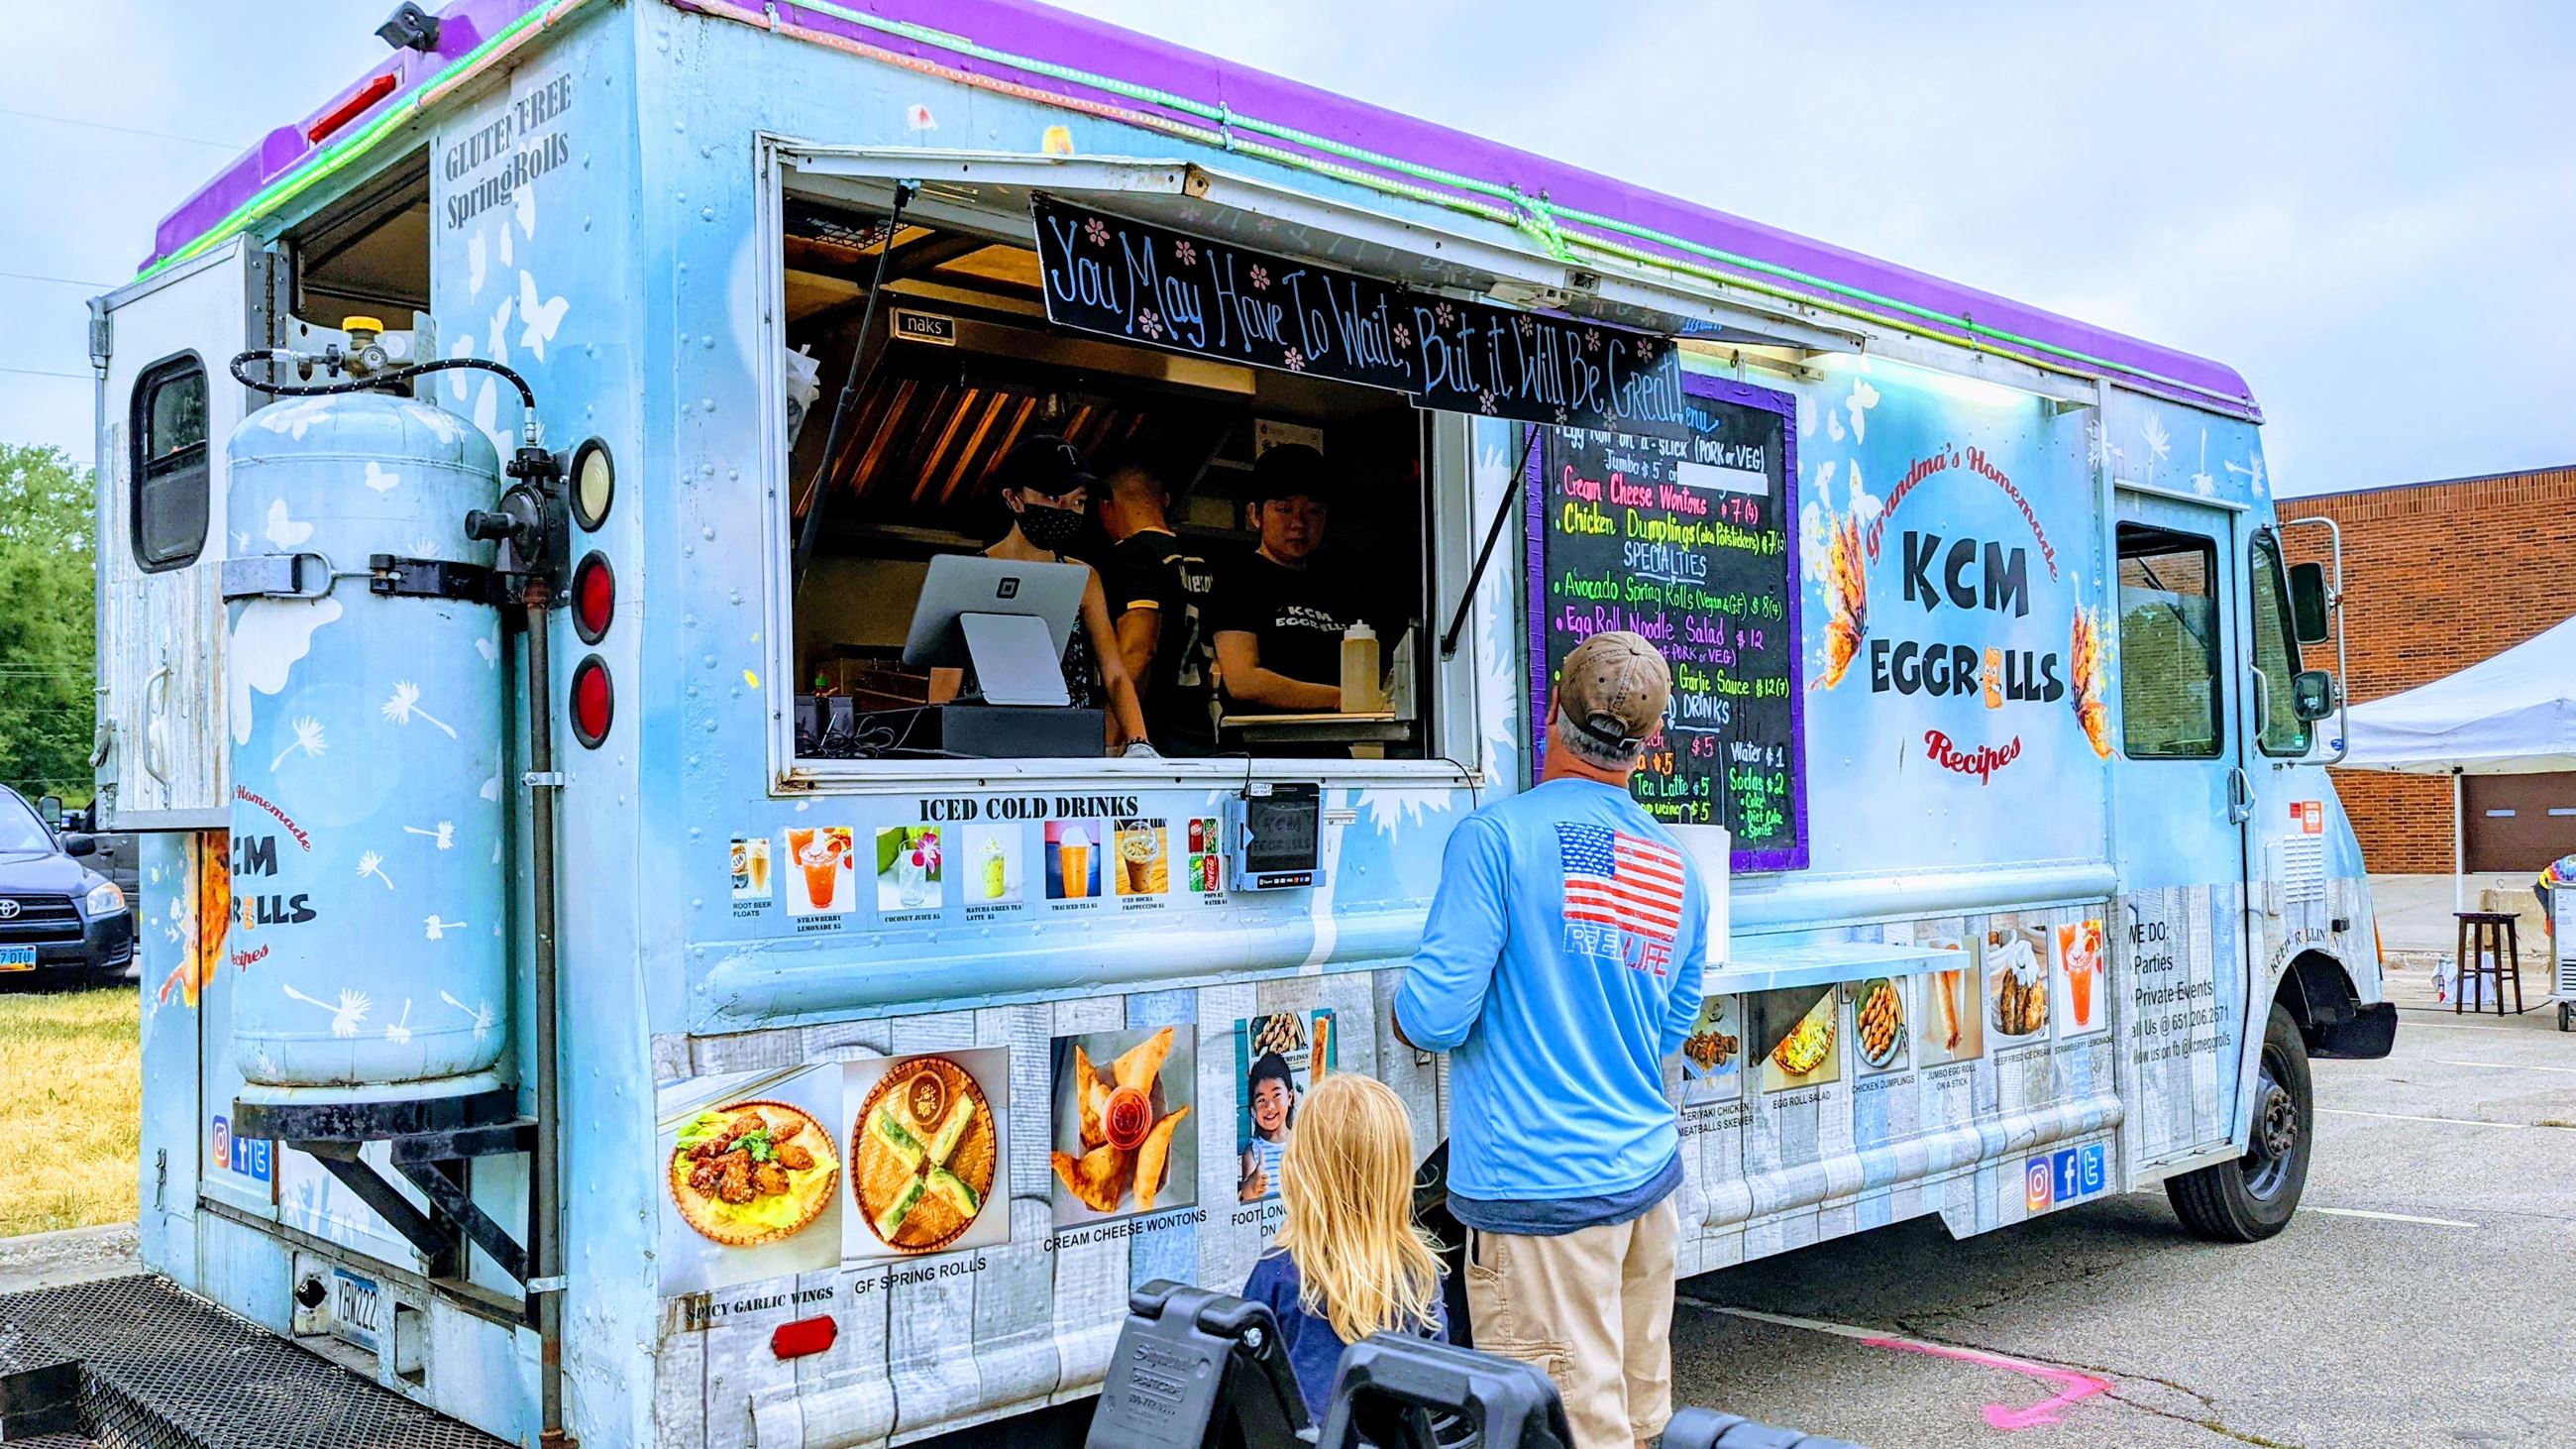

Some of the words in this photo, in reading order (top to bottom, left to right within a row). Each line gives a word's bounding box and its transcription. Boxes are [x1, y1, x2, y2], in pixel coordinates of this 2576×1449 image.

[446, 115, 512, 182] GLUTEN
[515, 72, 572, 137] FREE
[908, 317, 942, 334] naks
[1047, 215, 1123, 314] You
[1120, 231, 1205, 348] May
[1207, 249, 1288, 353] Have
[1282, 270, 1330, 361] To
[1414, 306, 1480, 396] But
[1510, 317, 1566, 407] Will
[1565, 330, 1604, 413] Be
[1685, 406, 1719, 434] enu
[1604, 448, 1640, 475] Jumbo
[1695, 435, 1725, 466] (PORK
[1736, 445, 1765, 474] VEG)
[1564, 465, 1603, 502] Cream
[1610, 473, 1654, 507] Cheese
[1660, 484, 1707, 515] Wontons
[1865, 442, 1961, 567] Grandma's
[1966, 445, 2060, 583] Homemade
[1563, 502, 1617, 535] Chicken
[1627, 507, 1695, 552] Dumplings
[1902, 530, 2029, 618] KCM
[1564, 570, 1619, 600] Avocado
[1625, 576, 1662, 614] Spring
[1665, 583, 1693, 610] Rolls
[1594, 605, 1621, 632] Roll
[1629, 612, 1675, 640] Noodle
[1685, 613, 1725, 645] Salad
[1678, 663, 1711, 691] Garlic
[1717, 669, 1751, 695] Sauce
[1730, 740, 1762, 762] Water
[1924, 729, 2021, 787] Recipes
[1635, 773, 1656, 796] Tea
[1660, 774, 1689, 797] Latte
[1729, 766, 1764, 791] Sodas
[236, 784, 312, 853] Homemade
[919, 799, 978, 822] ICED
[985, 797, 1047, 820] COLD
[1055, 795, 1139, 818] DRINKS
[1747, 809, 1764, 824] Diet
[797, 915, 841, 924] STRAWBERRY
[797, 923, 832, 932] LEMONADE
[2148, 921, 2170, 943] DO:
[231, 944, 269, 972] ecipes
[2134, 952, 2173, 975] Parties
[2135, 985, 2174, 1008] Private
[2177, 978, 2213, 1001] Events
[2131, 1020, 2142, 1039] all
[2144, 1018, 2158, 1036] Us
[2160, 1015, 2170, 1037] @
[2150, 1048, 2159, 1061] us
[2161, 1045, 2171, 1059] on
[1852, 1081, 1879, 1094] CHICKEN
[1879, 1074, 1915, 1088] DUMPLINGS
[1927, 1068, 1948, 1080] JUMBO
[1948, 1066, 1961, 1076] EGG
[1961, 1063, 1977, 1073] ROLL
[1951, 1077, 1969, 1088] STICK
[1682, 1107, 1716, 1122] TERIYAKI
[1717, 1102, 1750, 1117] CHICKEN
[1772, 1097, 1788, 1110] EGG
[1789, 1094, 1807, 1108] ROLL
[1808, 1090, 1831, 1104] SALAD
[1678, 1120, 1722, 1137] MEATBALLS
[1723, 1114, 1755, 1130] SKEWER
[1043, 1231, 1091, 1253] CREAM
[1093, 1220, 1144, 1242] CHEESE
[1146, 1209, 1208, 1232] WONTONS
[1260, 1224, 1276, 1238] ON
[854, 1280, 877, 1294] GF
[880, 1266, 936, 1289] SPRING
[938, 1257, 988, 1279] ROLLS
[686, 1302, 731, 1321] SPICY
[734, 1293, 787, 1314] GARLIC
[790, 1286, 834, 1305] WINGS
